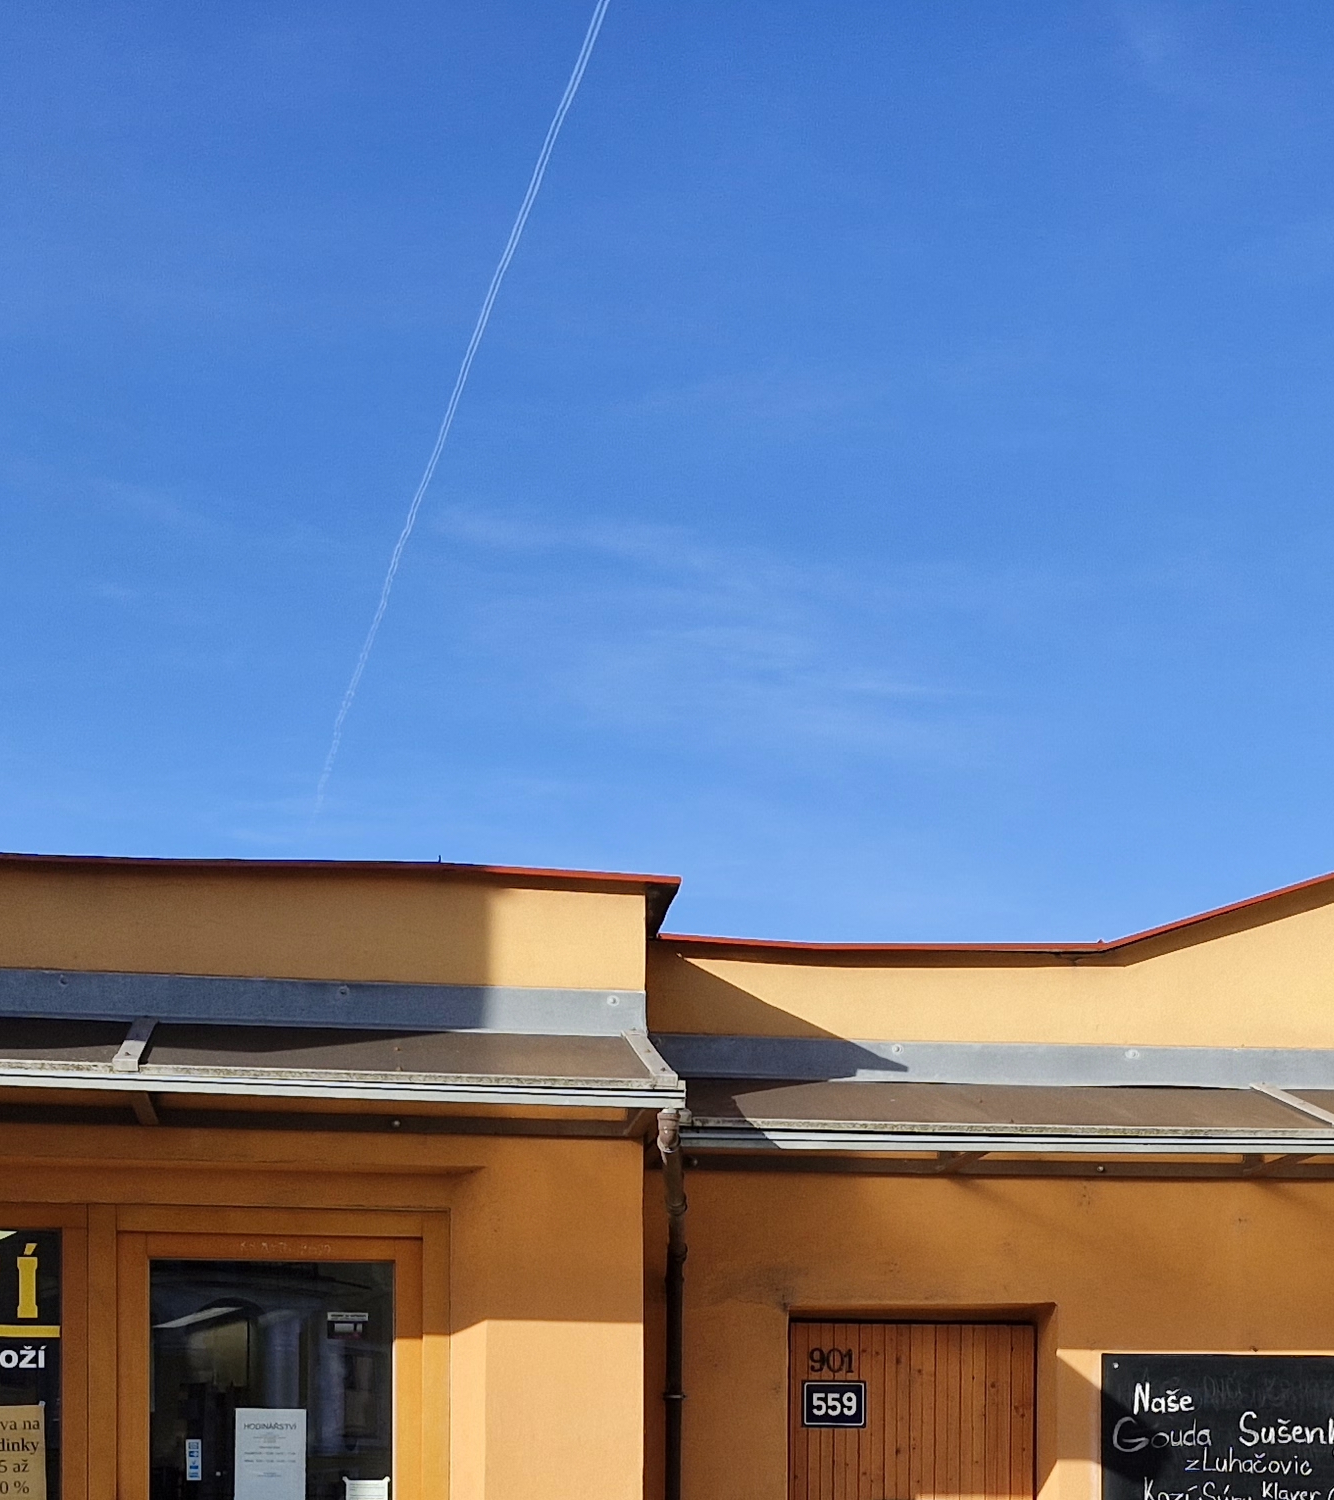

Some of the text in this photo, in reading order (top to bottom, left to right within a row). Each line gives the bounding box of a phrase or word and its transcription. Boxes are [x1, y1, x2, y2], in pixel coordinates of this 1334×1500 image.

[809, 1347, 854, 1373] 901
[812, 1391, 857, 1416] 559
[1133, 1382, 1195, 1415] Naše
[22, 1420, 40, 1430] na
[1113, 1416, 1212, 1452] Gouda
[13, 1458, 30, 1473] až
[13, 1480, 30, 1494] %
